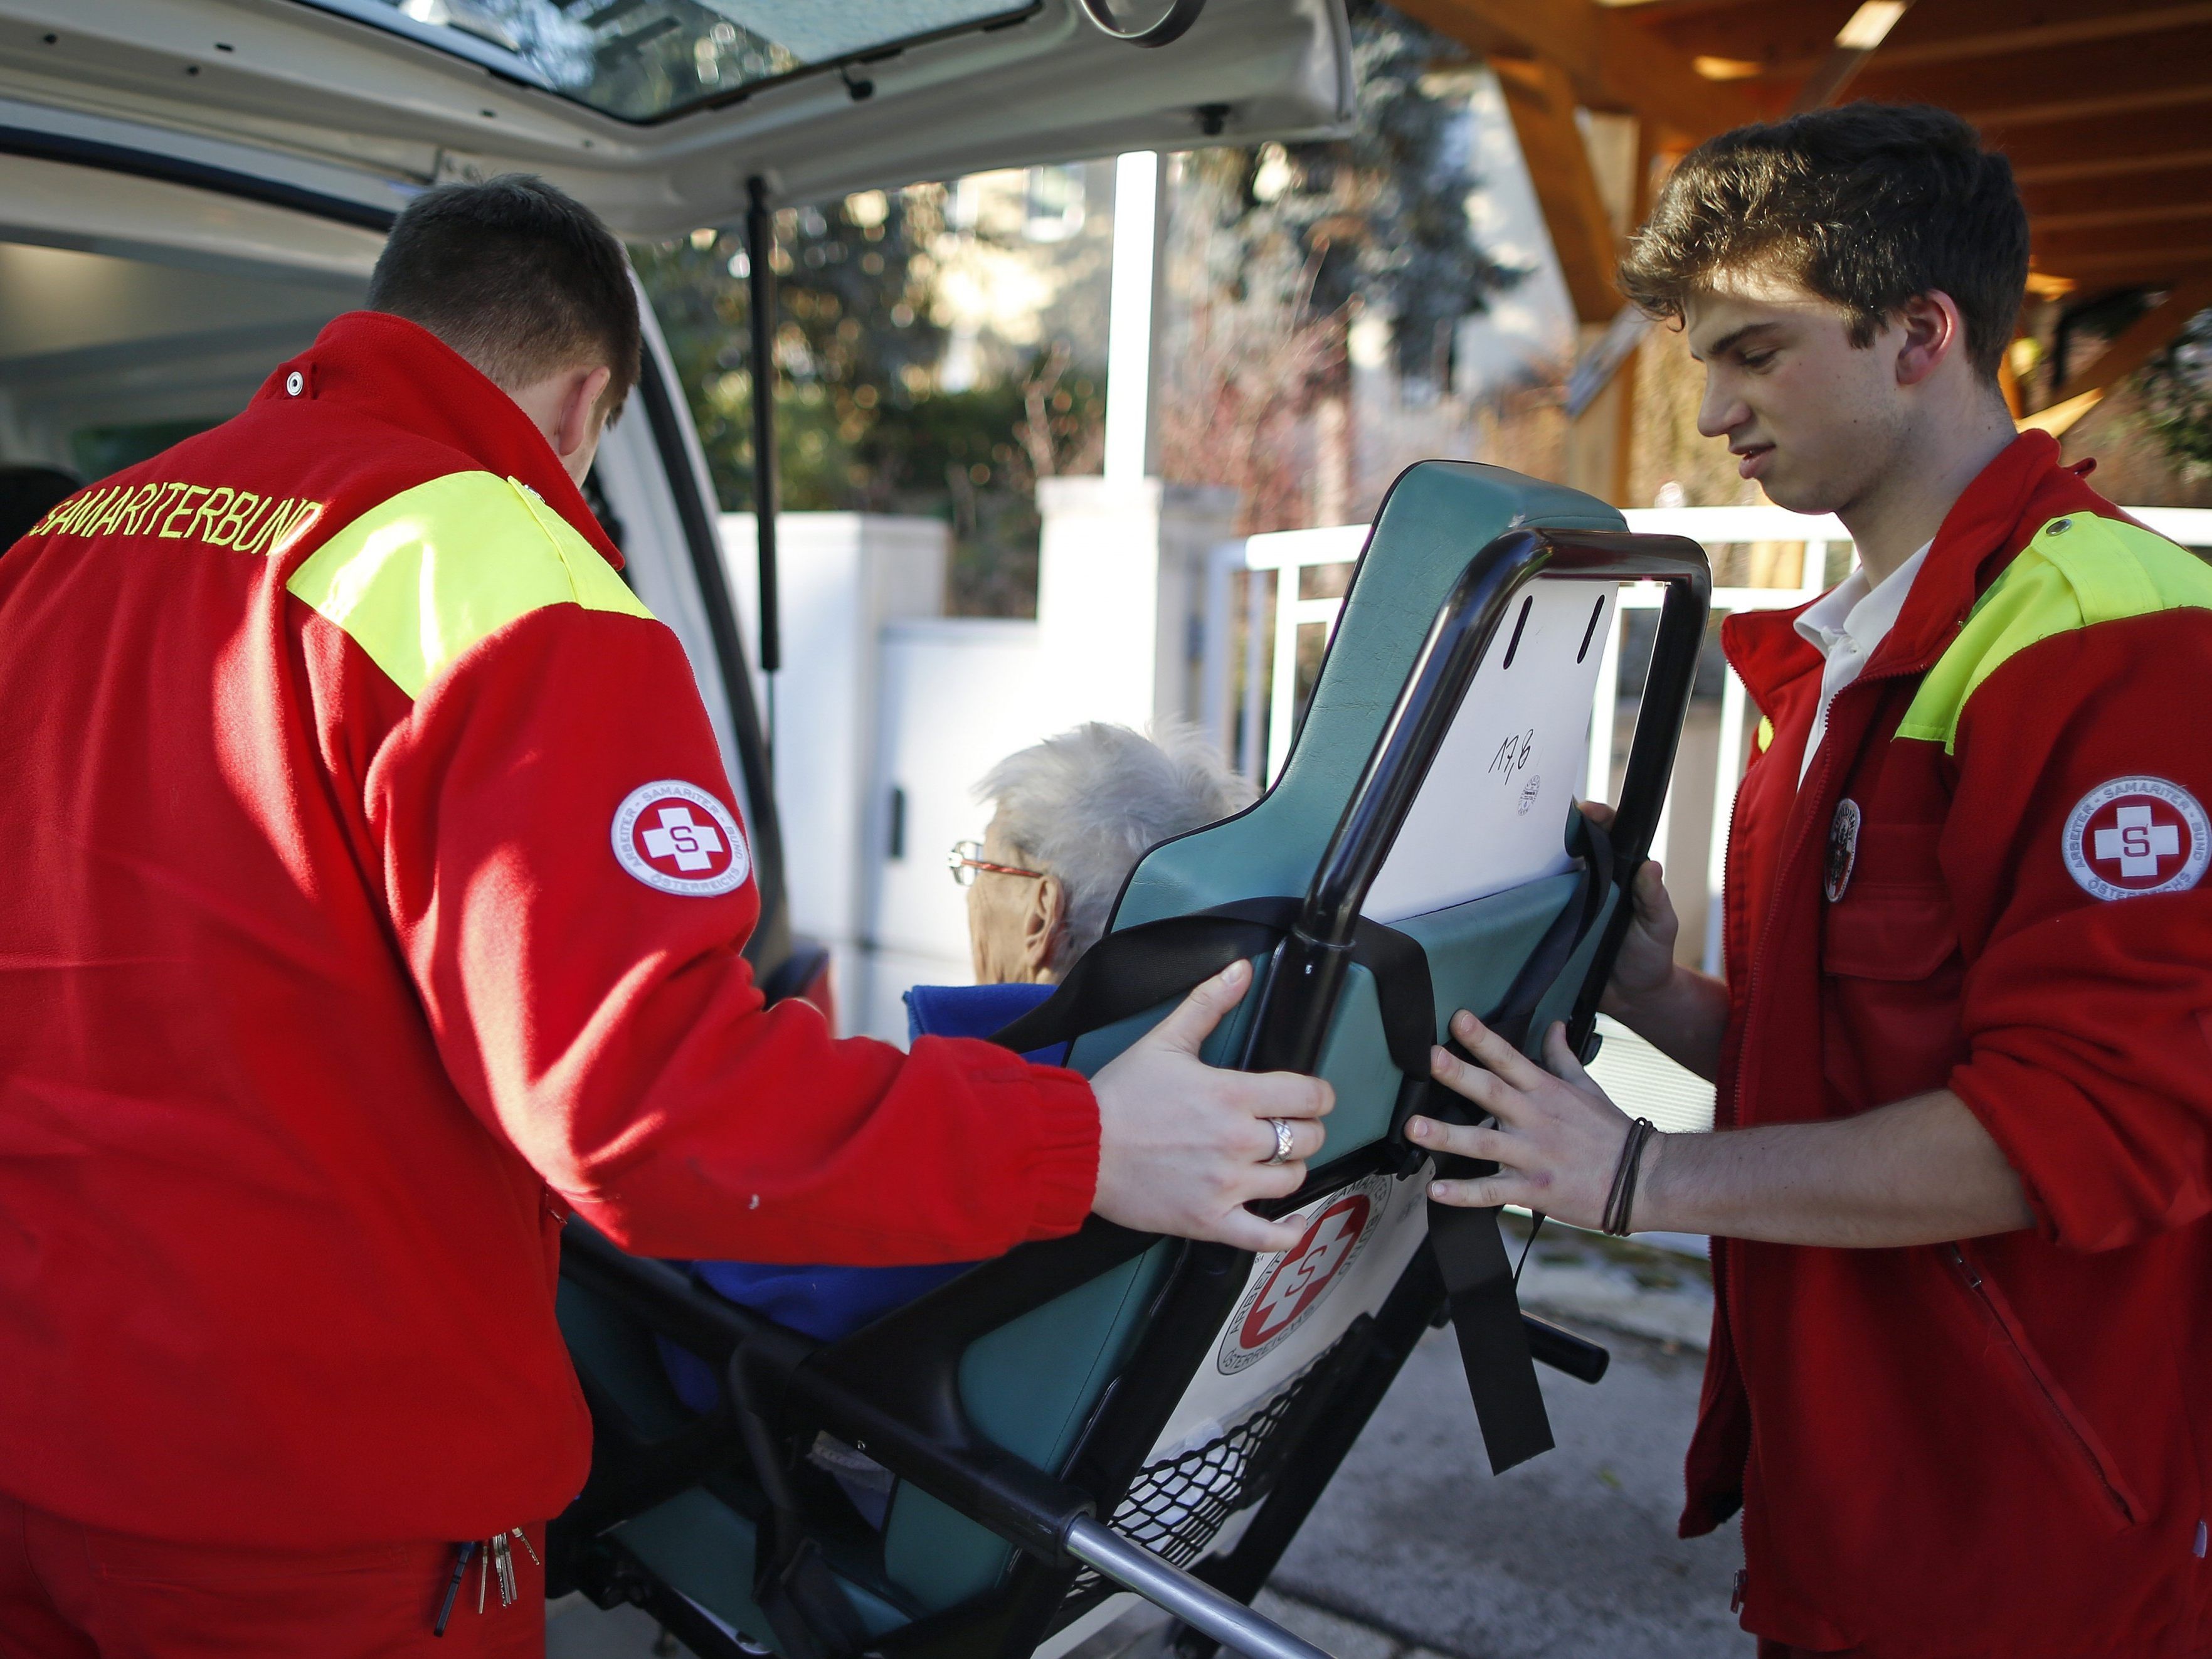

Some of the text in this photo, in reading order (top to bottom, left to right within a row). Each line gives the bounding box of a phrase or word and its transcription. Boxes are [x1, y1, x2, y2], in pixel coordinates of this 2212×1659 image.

[29, 482, 323, 556] SAMARITERBUND
[620, 787, 743, 867] ARBEITER SAMARITER BUND
[669, 825, 699, 853] S
[2070, 782, 2206, 869] ARBEITER SAMARITER BUND
[2123, 826, 2151, 857] S
[1284, 1244, 1328, 1298] S
